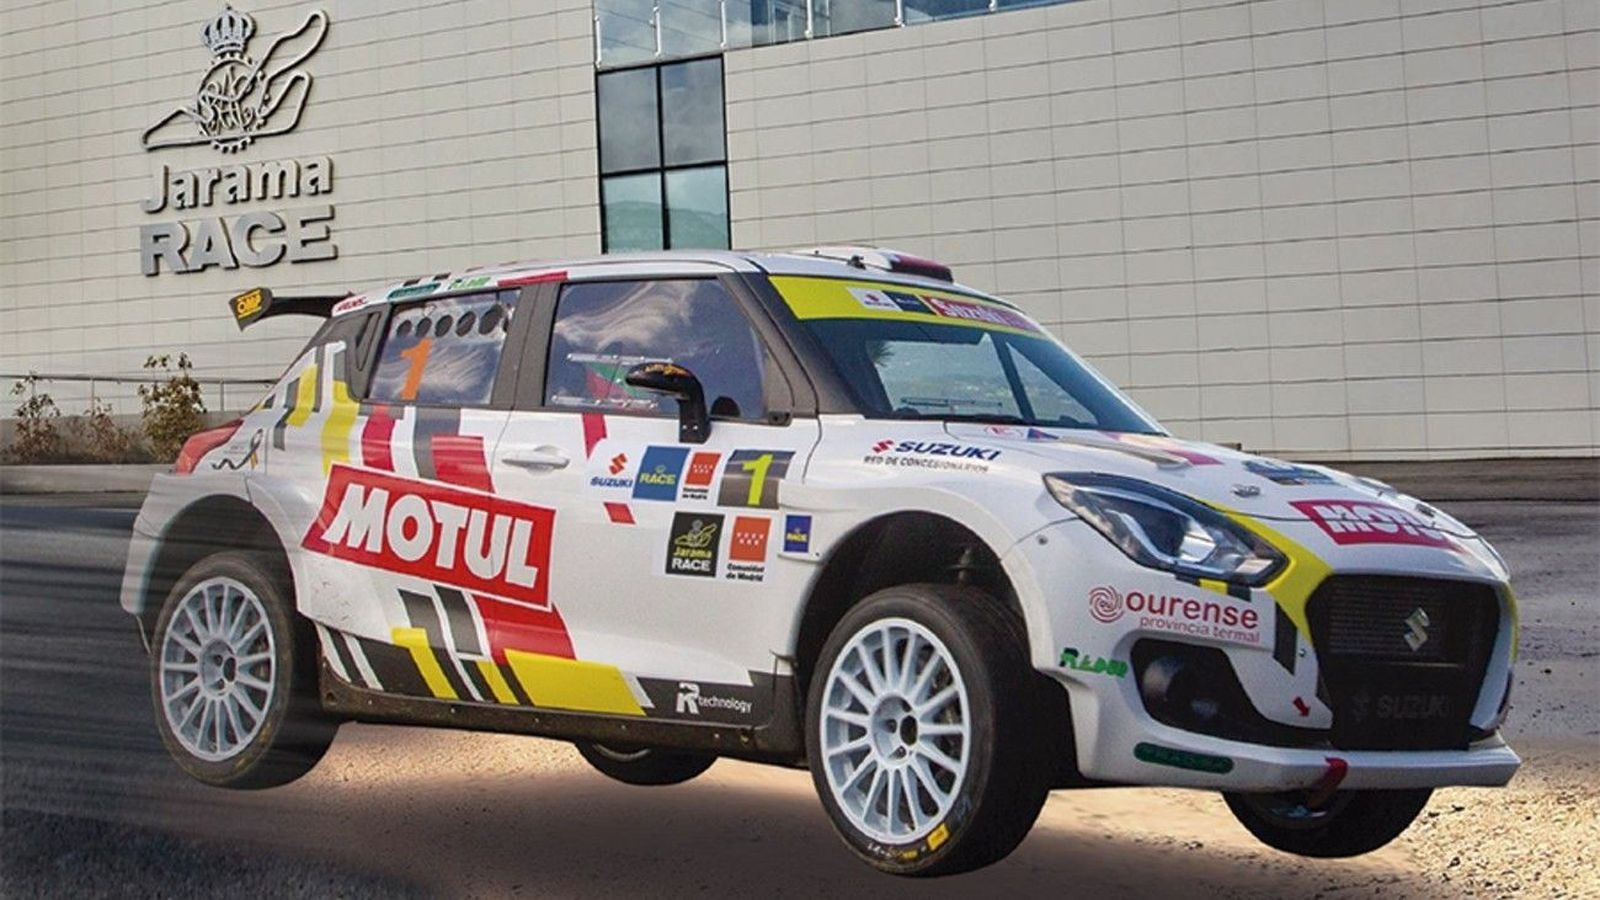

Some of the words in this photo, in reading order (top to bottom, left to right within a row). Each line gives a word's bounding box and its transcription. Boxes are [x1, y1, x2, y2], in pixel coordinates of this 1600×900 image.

[141, 156, 333, 213] Jarama
[139, 205, 338, 277] RACE
[401, 338, 433, 400] 1
[895, 441, 1001, 461] SUZUKI
[885, 456, 899, 466] DE
[590, 476, 633, 488] SUZUKI
[640, 472, 676, 485] RACE
[742, 454, 773, 505] 1
[321, 483, 538, 589] MOTUL
[786, 532, 807, 542] RACE
[673, 546, 712, 558] Jarama
[671, 558, 711, 572] RACE
[727, 563, 764, 573] Comunidad
[726, 572, 736, 580] de
[738, 572, 763, 581] Madrid
[1126, 591, 1258, 630] ourense
[1140, 615, 1210, 636] provincia
[1213, 626, 1260, 643] termal
